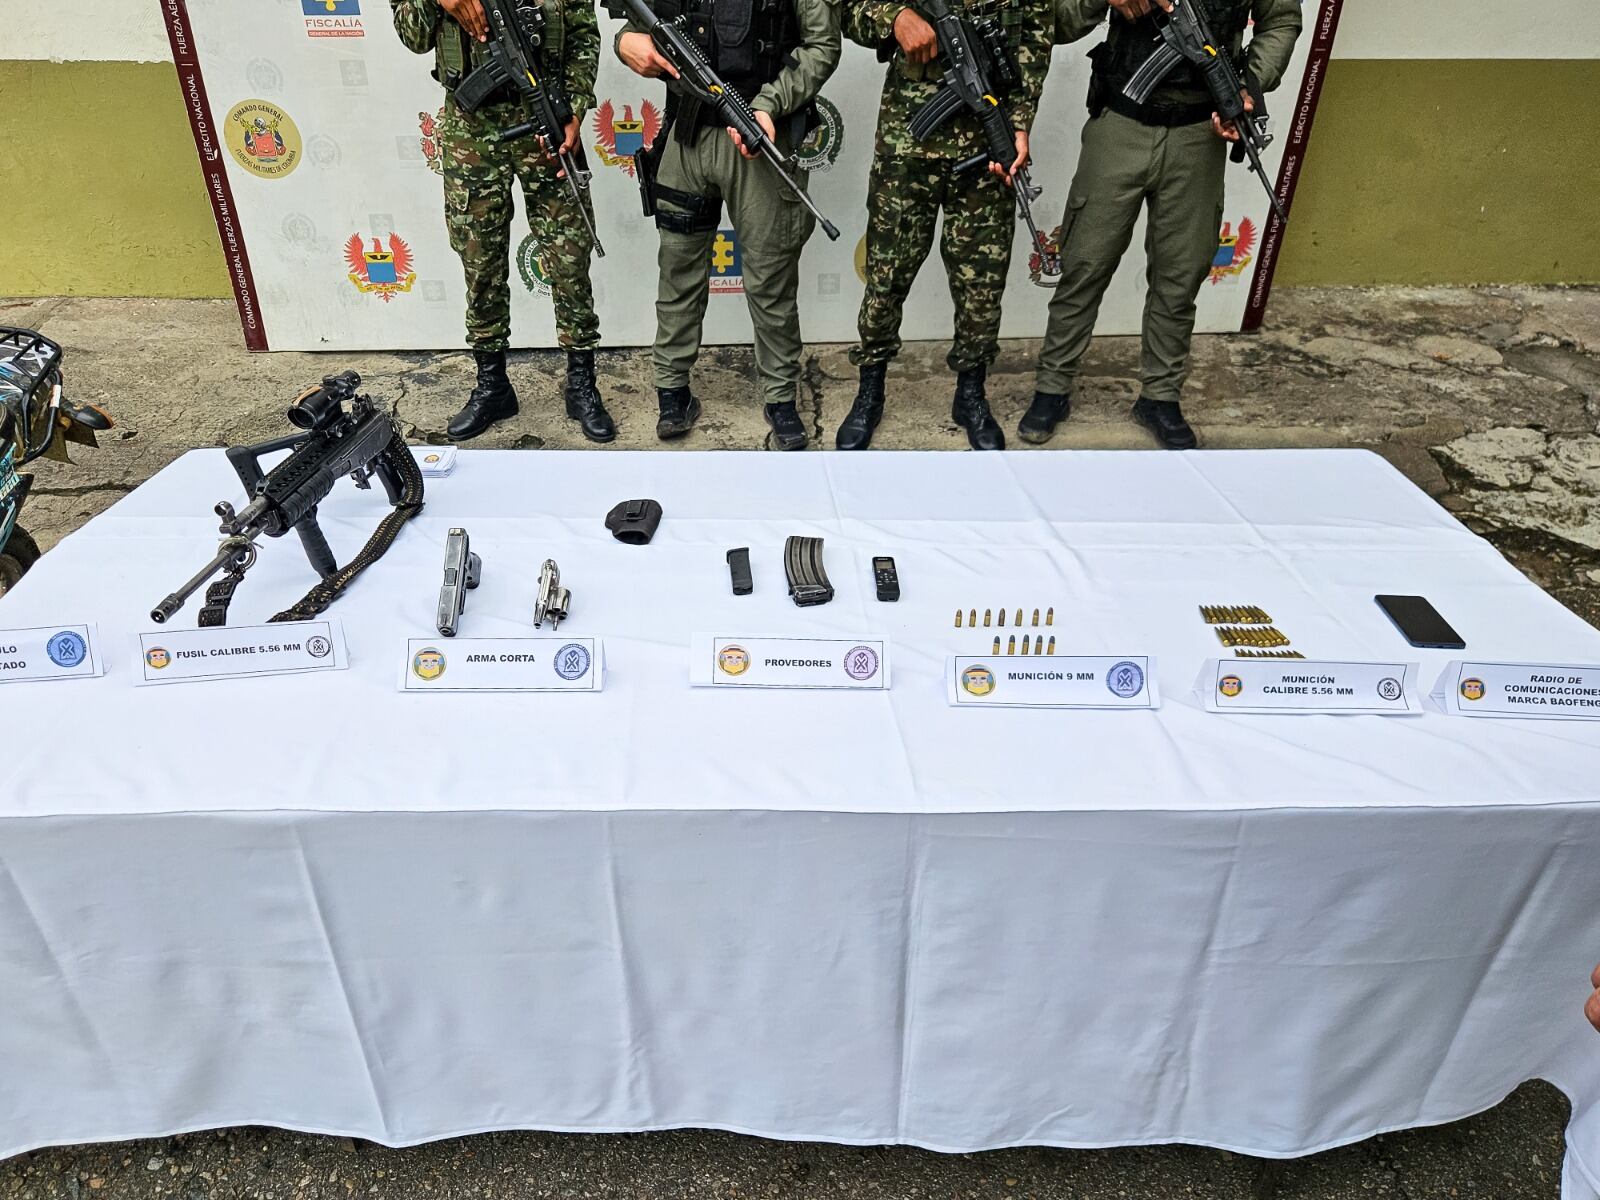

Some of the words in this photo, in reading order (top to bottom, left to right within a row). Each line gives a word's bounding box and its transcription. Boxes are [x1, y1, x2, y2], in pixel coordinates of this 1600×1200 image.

[168, 0, 179, 17] AÉR
[305, 17, 362, 27] FISCALÍA
[173, 18, 188, 54] FUERZA
[186, 74, 203, 119] NACIONAL
[233, 104, 257, 121] COMANDO
[258, 105, 284, 122] GENERAL
[198, 122, 215, 161] EJÉRCITO
[1262, 233, 1277, 268] GENERAL
[1280, 155, 1296, 197] MILITARES
[1303, 58, 1321, 104] NACIONAL
[1320, 5, 1335, 40] FUERZA
[235, 149, 253, 167] FUERZAS
[252, 163, 276, 174] MILITARES
[211, 173, 229, 215] MILITARES
[223, 217, 238, 252] FUERZAS
[525, 240, 539, 269] REPUBLIC
[233, 254, 247, 288] GENERAL
[241, 290, 256, 329] COMANDO
[0, 645, 17, 654] LO
[176, 650, 208, 659] FUSIL
[210, 646, 256, 657] CALIBRE
[258, 644, 281, 653] 5.56
[283, 643, 301, 651] MM
[466, 654, 497, 663] ARMA
[499, 654, 536, 663] CORTA
[764, 658, 832, 668] PROVEDORES
[1008, 670, 1063, 681] MUNICIÓN
[1066, 672, 1074, 681] 9
[1076, 672, 1095, 681] MM
[1281, 674, 1336, 684] MUNICIÓN
[1530, 674, 1565, 684] RADIO
[1567, 676, 1583, 685] DE
[1262, 686, 1308, 695] CALIBRE
[1311, 687, 1334, 695] 5.56
[1336, 687, 1354, 695] MM
[1507, 695, 1547, 705] MARCA
